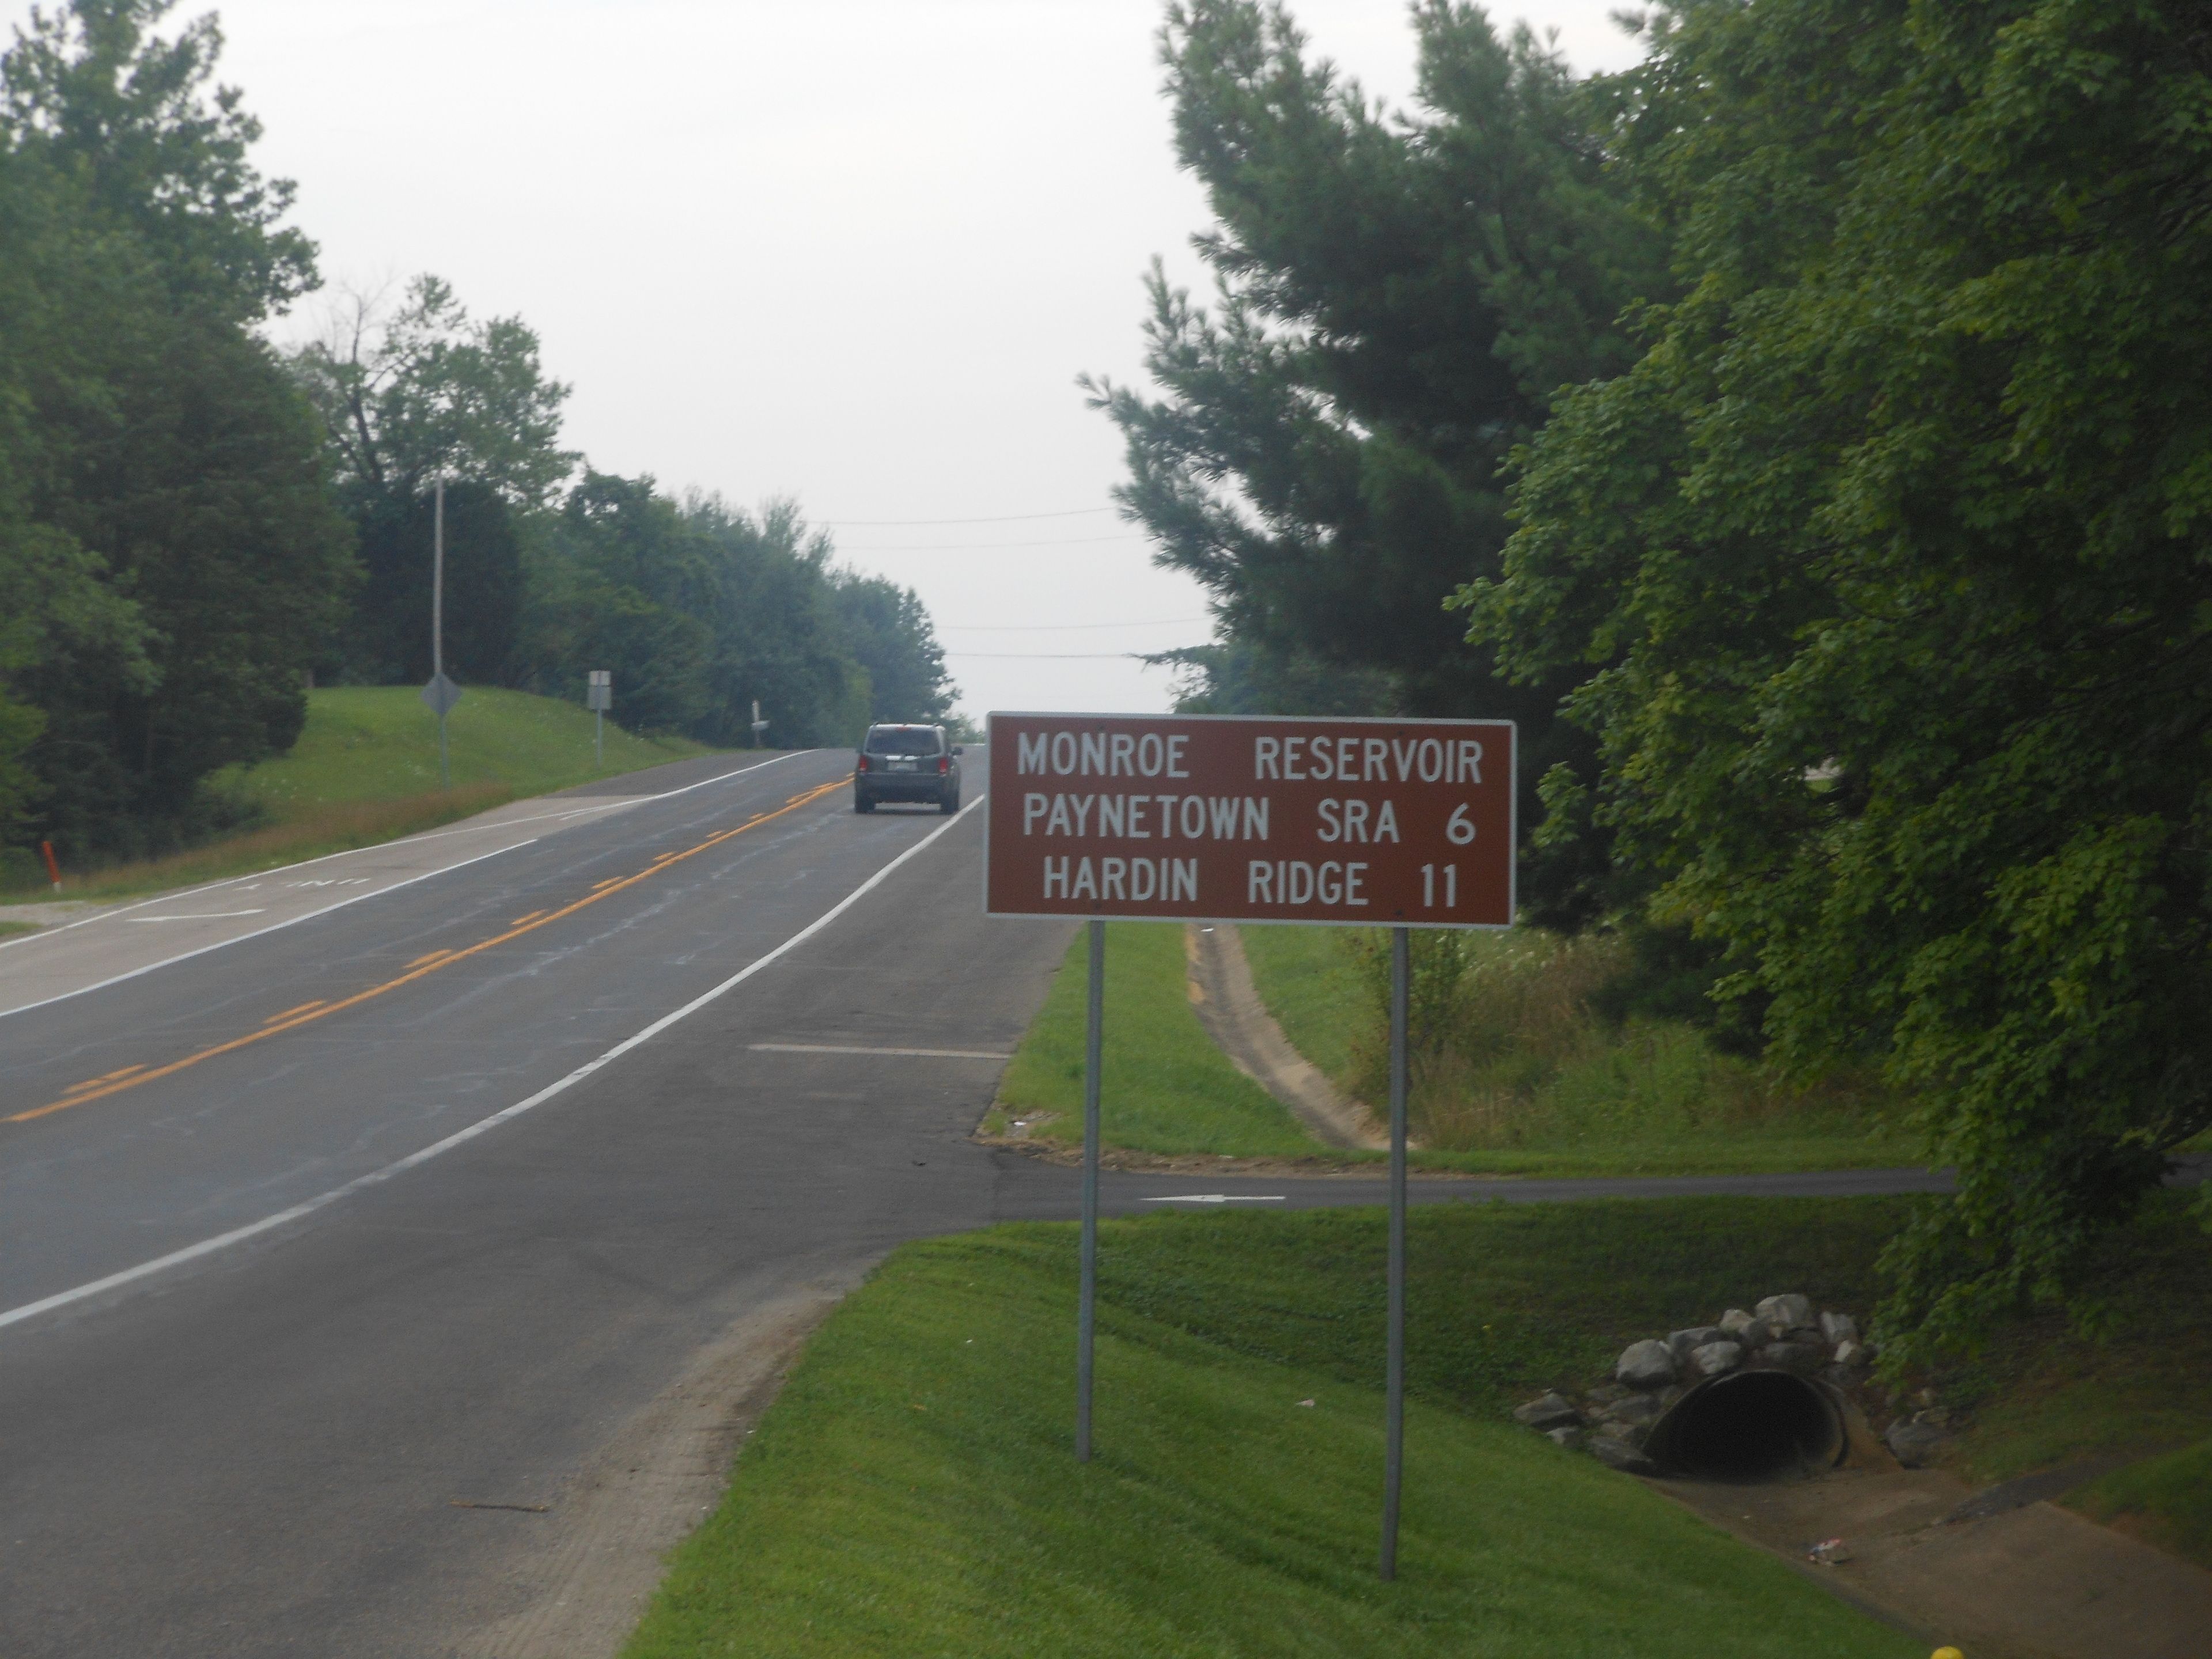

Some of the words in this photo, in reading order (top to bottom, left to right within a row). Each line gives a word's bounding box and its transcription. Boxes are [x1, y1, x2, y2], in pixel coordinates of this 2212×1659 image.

[1017, 730, 1191, 779] MONROE
[1255, 735, 1483, 784] RESERVOIR
[1023, 792, 1269, 841] PAYNETOWN
[1316, 797, 1400, 844] SRA
[1446, 802, 1476, 845] 6
[1043, 856, 1198, 902] HARDIN
[1248, 860, 1369, 906] RIDGE
[1421, 863, 1457, 908] 11
